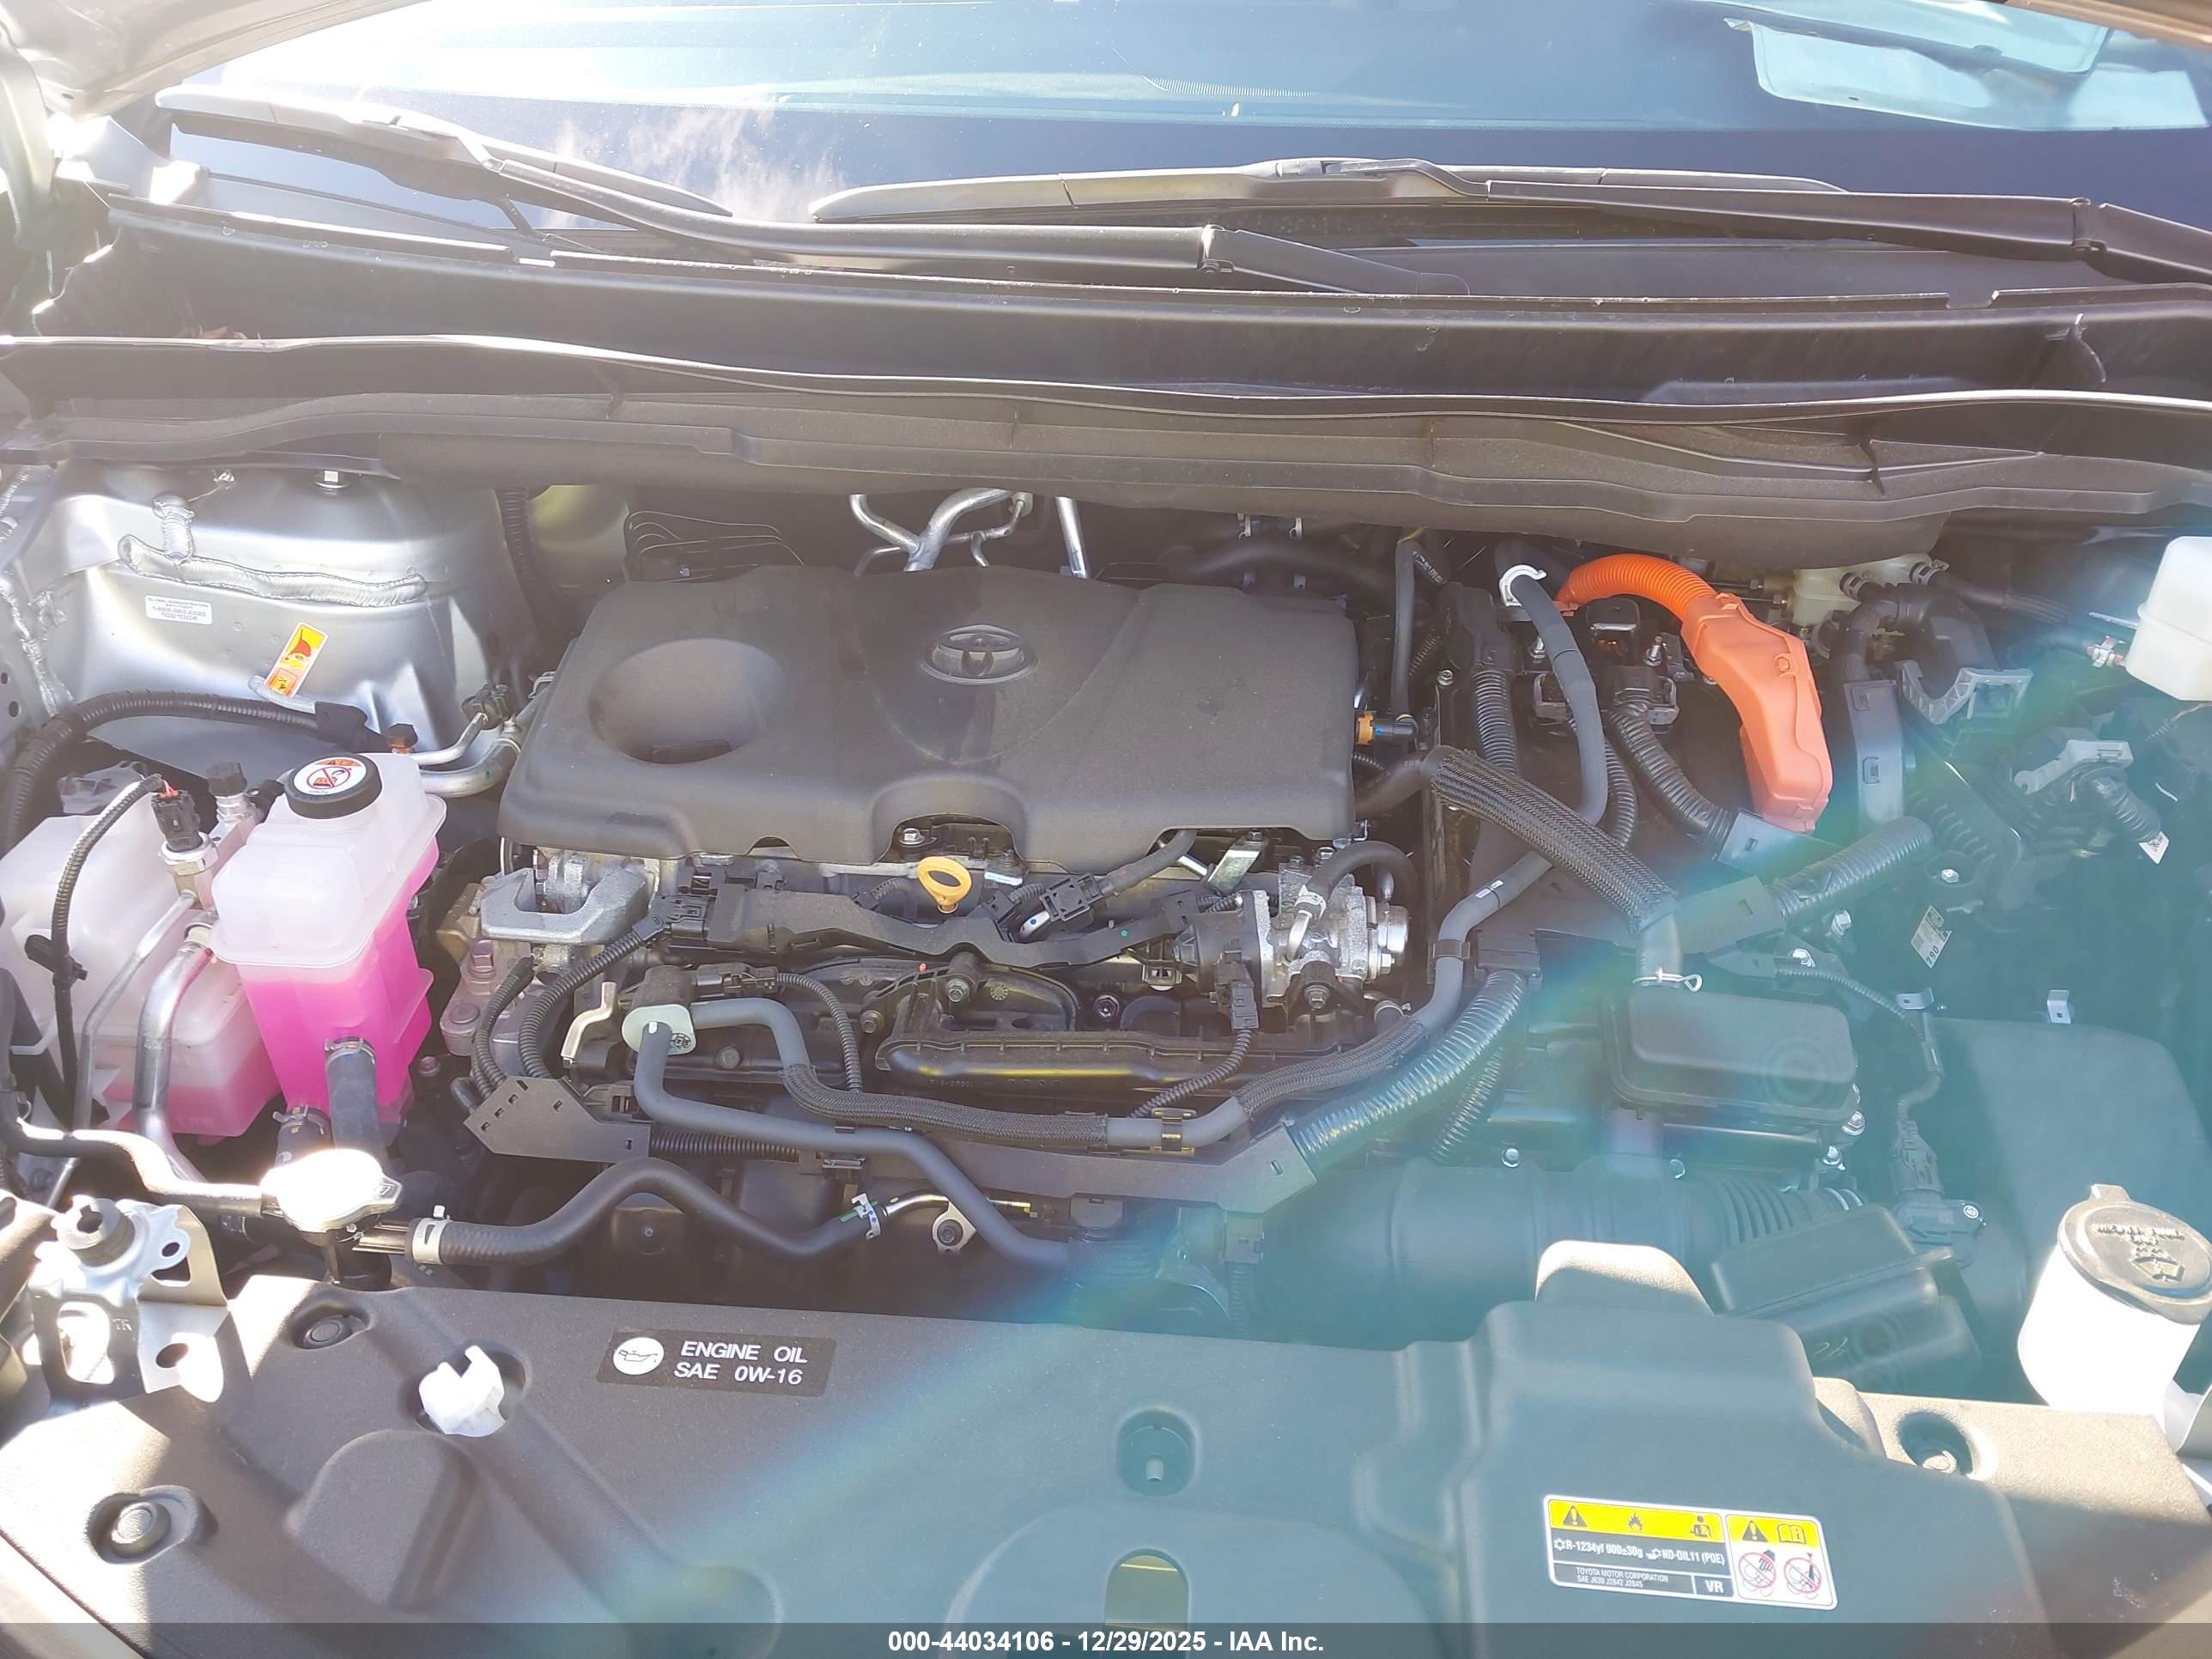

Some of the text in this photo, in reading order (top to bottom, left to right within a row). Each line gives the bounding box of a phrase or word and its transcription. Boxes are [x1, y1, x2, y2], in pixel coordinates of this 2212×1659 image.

[680, 1340, 808, 1364] ENGINE OIL
[674, 1362, 804, 1385] SAE 0W-16
[1565, 1539, 1725, 1566] R-1234yf 900±30g ND-OIL11 (POE)
[1577, 1567, 1668, 1583] TOYOTA MOTOR CORPORATION
[1577, 1575, 1589, 1583] SAE
[1590, 1577, 1605, 1585] J639
[1705, 1579, 1724, 1594] VR
